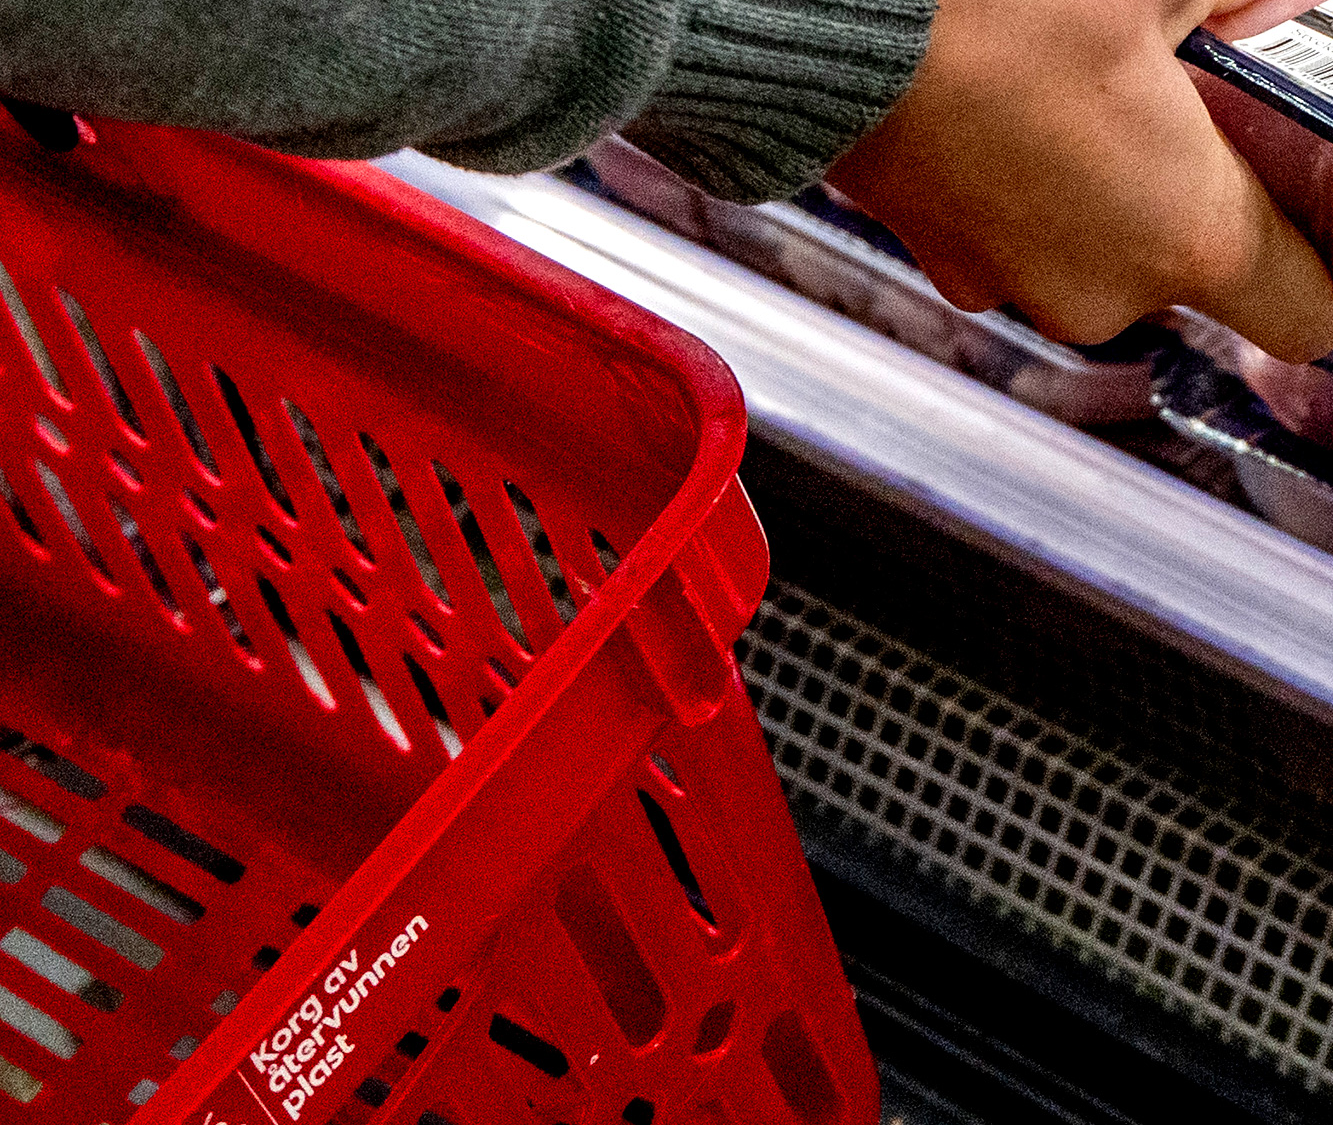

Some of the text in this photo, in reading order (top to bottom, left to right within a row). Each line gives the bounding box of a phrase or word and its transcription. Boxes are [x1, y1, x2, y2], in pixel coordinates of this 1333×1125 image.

[249, 948, 359, 1075] Korg av
[267, 914, 430, 1094] återvunnen
[281, 1033, 356, 1122] plast
